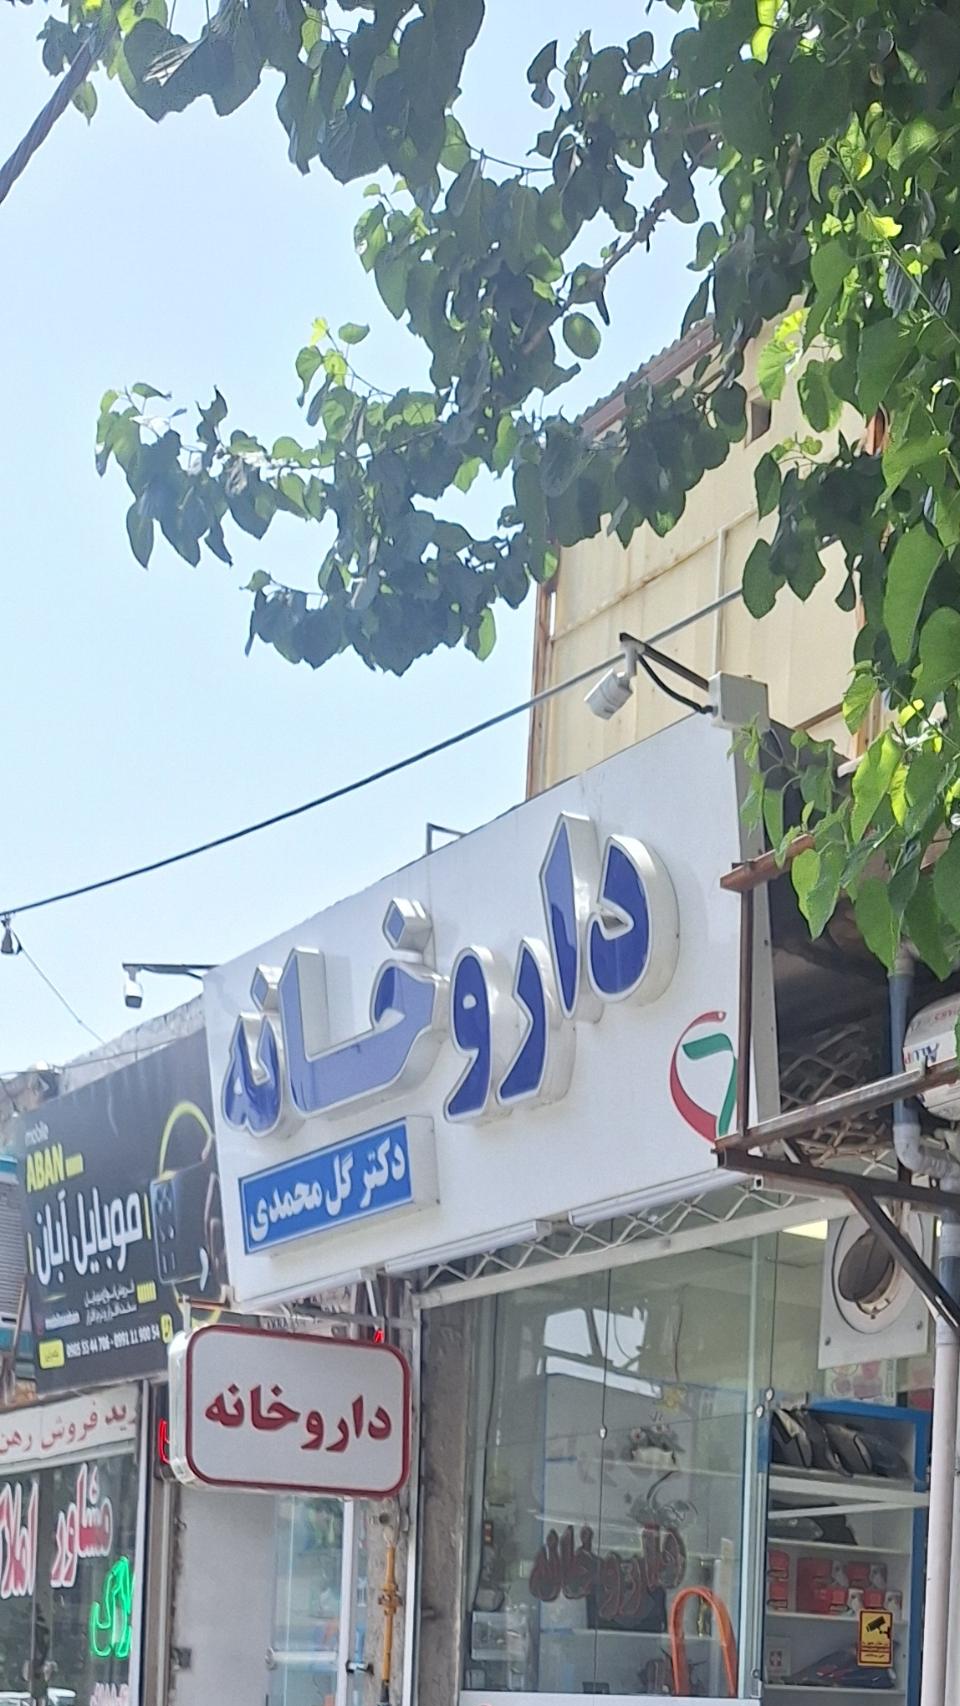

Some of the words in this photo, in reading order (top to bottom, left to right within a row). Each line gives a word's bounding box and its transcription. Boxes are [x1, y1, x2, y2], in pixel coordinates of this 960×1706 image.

[222, 811, 668, 1138] داروخانه
[27, 1142, 64, 1193] ABAN
[325, 1151, 354, 1216] گل
[360, 1137, 405, 1208] دکتر
[36, 1188, 70, 1286] آبان
[72, 1187, 142, 1276] موبایل
[250, 1180, 323, 1242] محمدی
[40, 1401, 98, 1449] فروش
[205, 1384, 392, 1452] داروخانه
[50, 1462, 112, 1587] مشاور
